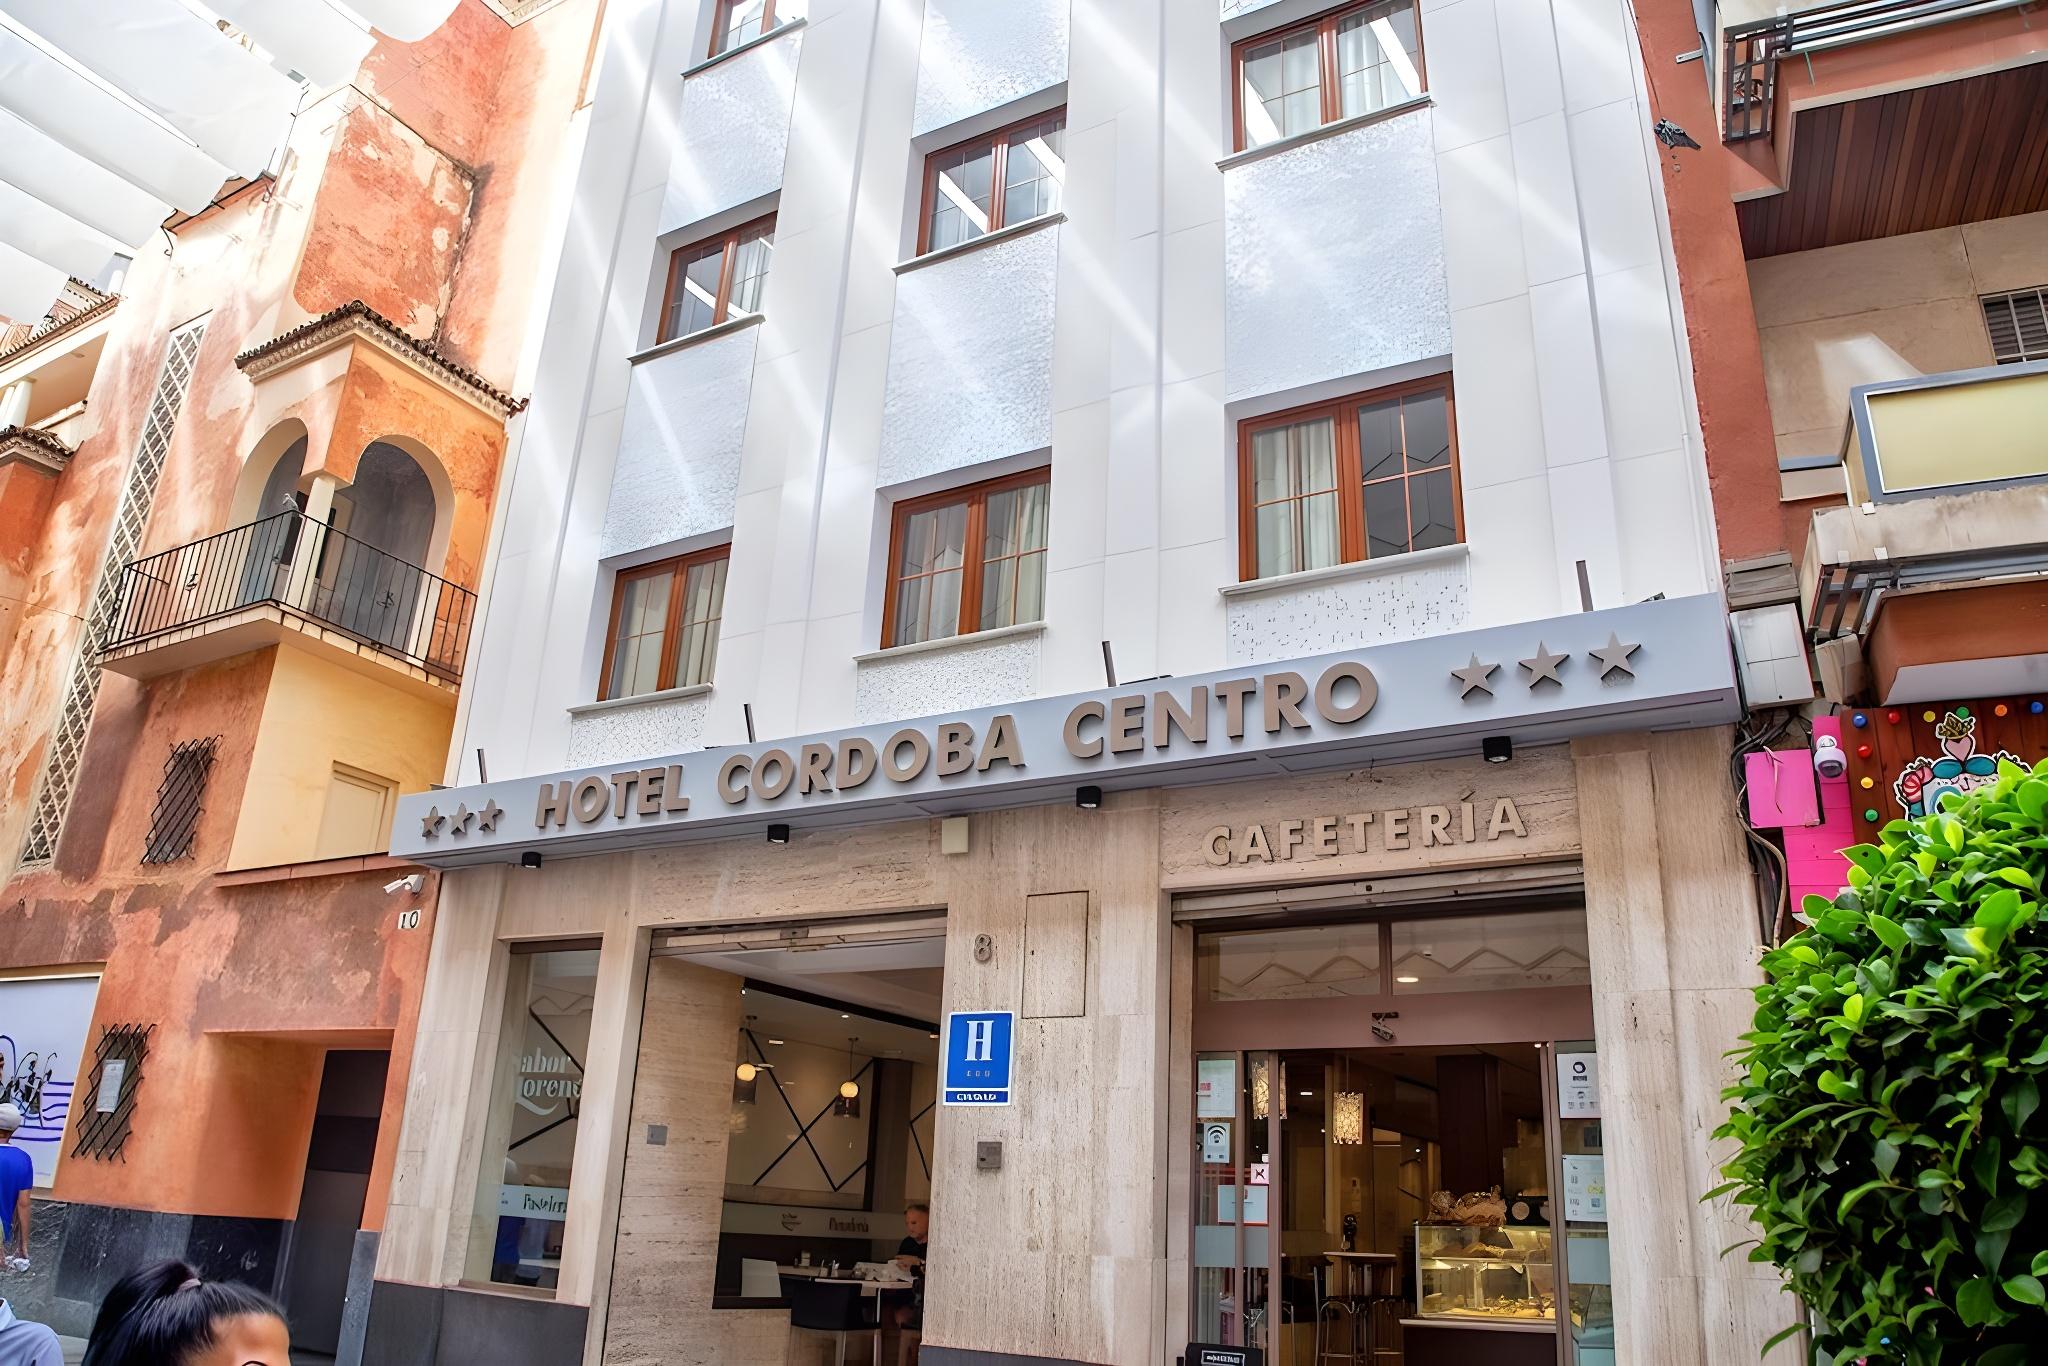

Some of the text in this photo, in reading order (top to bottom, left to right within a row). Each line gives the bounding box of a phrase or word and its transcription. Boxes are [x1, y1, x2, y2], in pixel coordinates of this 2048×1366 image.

[534, 661, 1379, 829] HOTEL CORDOBA CENTRO
[1202, 790, 1528, 867] CAFETERÍA
[400, 910, 419, 929] 10
[973, 933, 993, 965] 8
[964, 1020, 995, 1061] H
